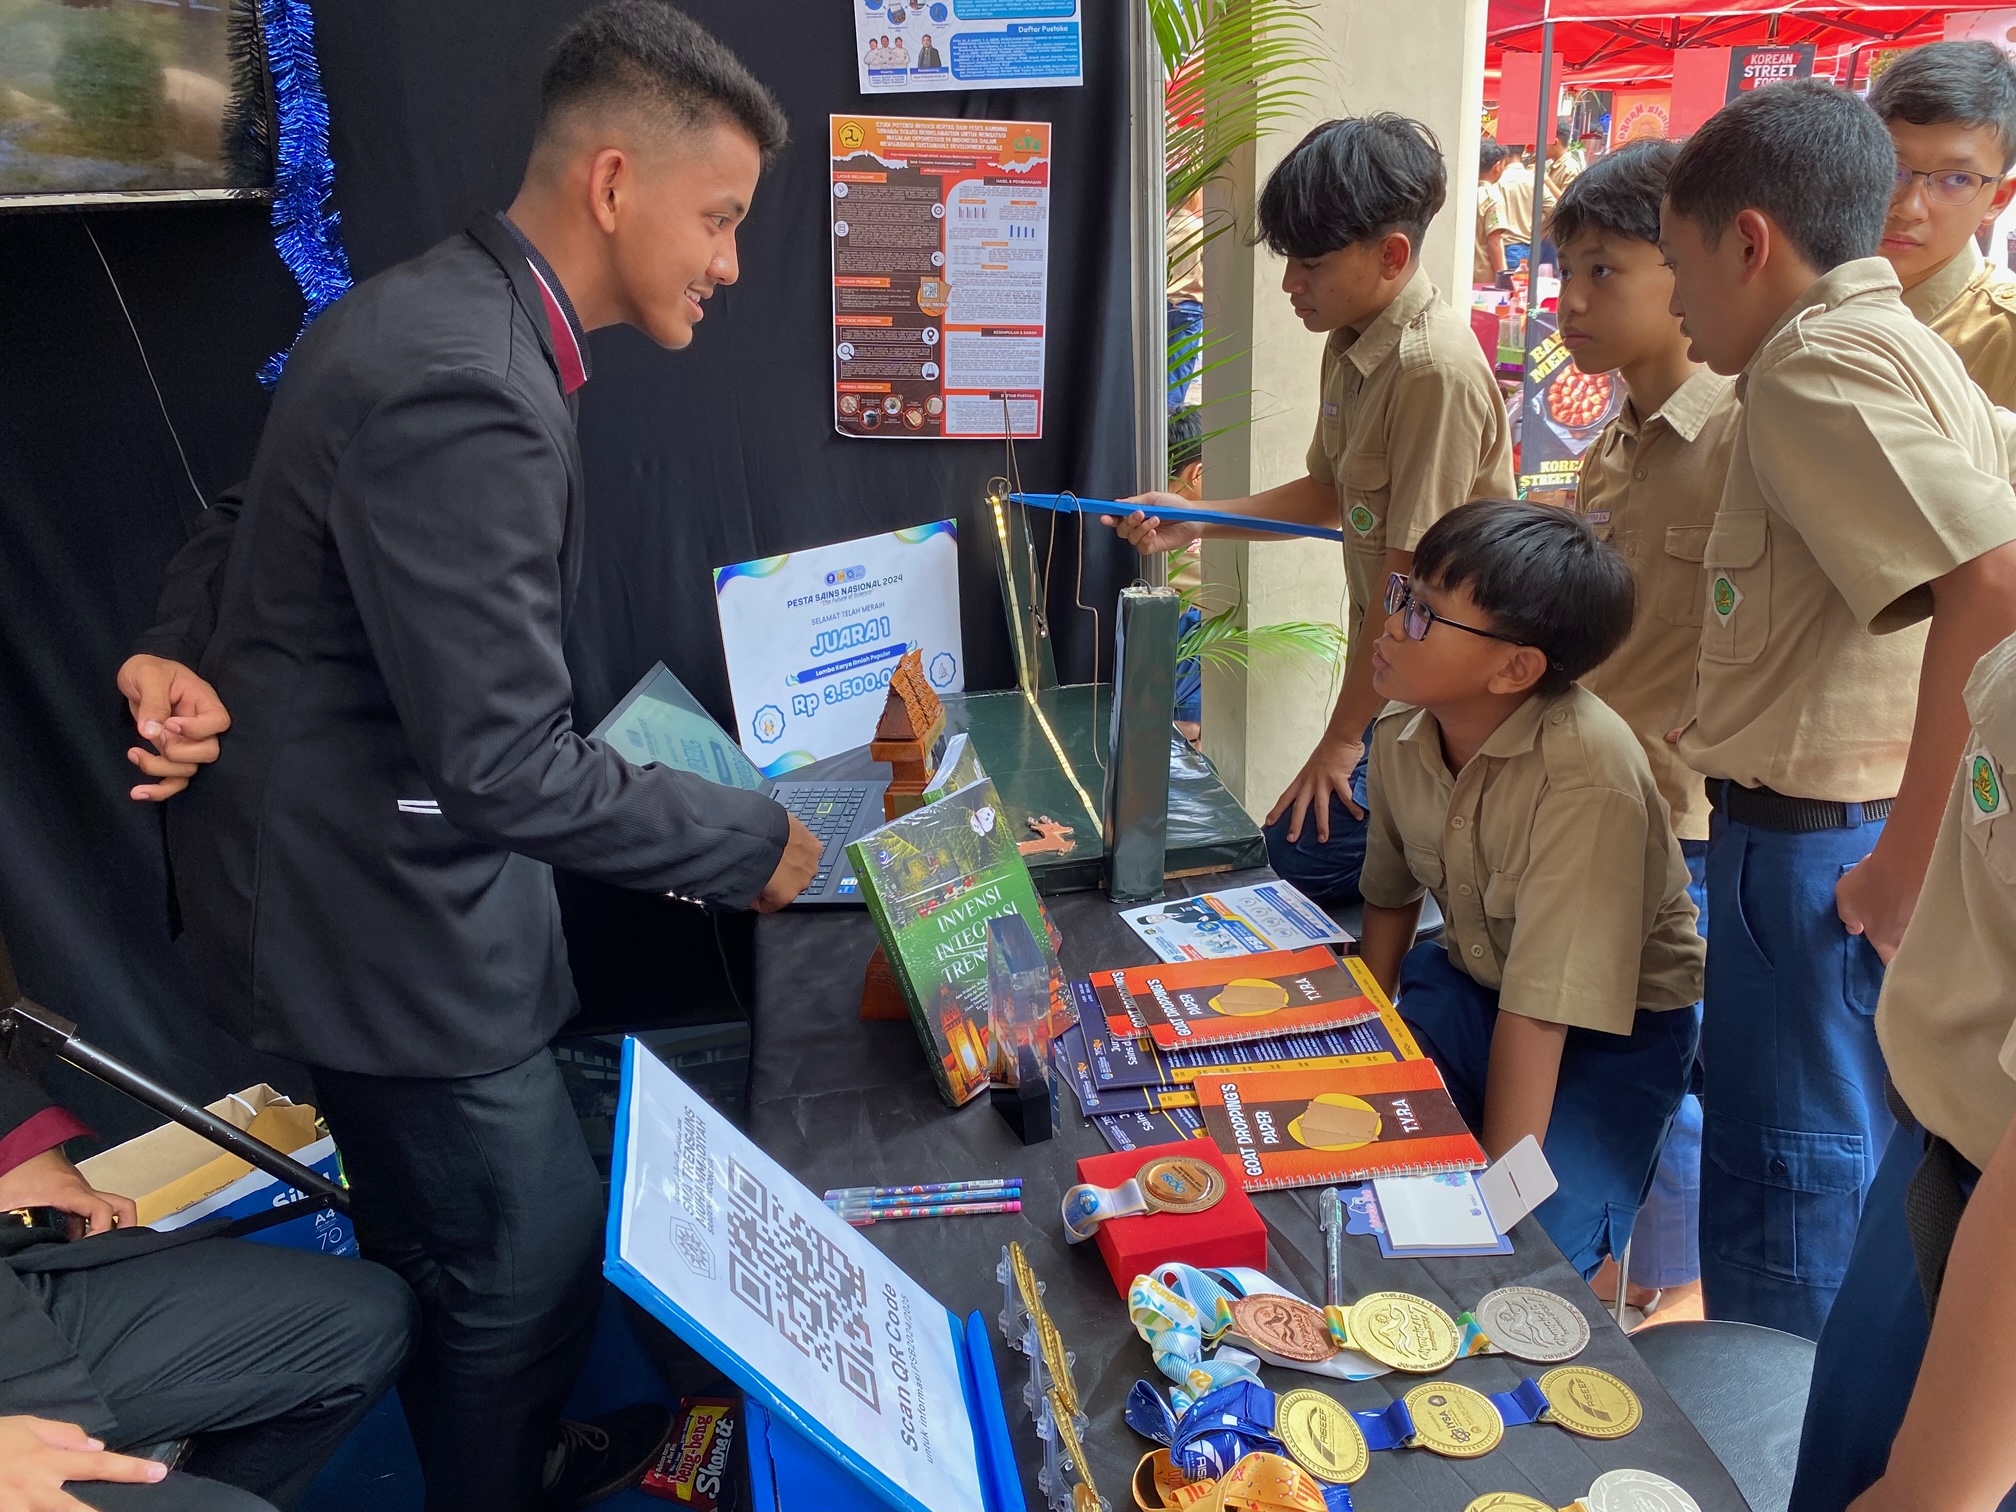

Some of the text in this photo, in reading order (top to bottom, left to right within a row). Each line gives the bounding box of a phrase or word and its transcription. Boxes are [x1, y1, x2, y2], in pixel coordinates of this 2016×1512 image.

[1018, 24, 1068, 33] Daftar Pustaka
[1744, 64, 1797, 78] STREET
[1750, 53, 1793, 64] KOREAN
[1520, 472, 1575, 488] STREET
[787, 574, 903, 608] PESTA SAINS NASIONAL 2024
[812, 601, 885, 626] SELAMAT TELAH MERAIH
[810, 616, 890, 657] JUARA 1
[816, 650, 891, 677] Lomba Karya Ilmiah Populer
[792, 665, 898, 717] Rp 3.500.0
[874, 908, 887, 933] INVENSI
[937, 884, 1002, 933] INVENSI
[935, 900, 1018, 961] INTEGSI
[1244, 935, 1268, 951] PSB
[941, 944, 988, 984] TREN
[1147, 978, 1178, 1018] DROPPING'S
[1178, 993, 1203, 1016] PAPER
[1169, 1015, 1192, 1036] GOAT
[1125, 1046, 1138, 1066] Sains
[1220, 1082, 1264, 1177] GOAT DROPPING'S
[1255, 1111, 1281, 1145] PAPER
[681, 1106, 696, 1216] SMA TRENSAINS
[694, 1116, 707, 1229] MUHAMMADIYAH
[315, 1208, 336, 1226] A4
[316, 1227, 342, 1250] 70
[882, 1283, 918, 1452] Scan QR Code
[901, 1293, 934, 1464] untuk informasi PSB2024/2025
[1440, 1410, 1457, 1431] IYSA
[667, 1414, 714, 1484] beng-beng
[695, 1417, 734, 1499] Share it
